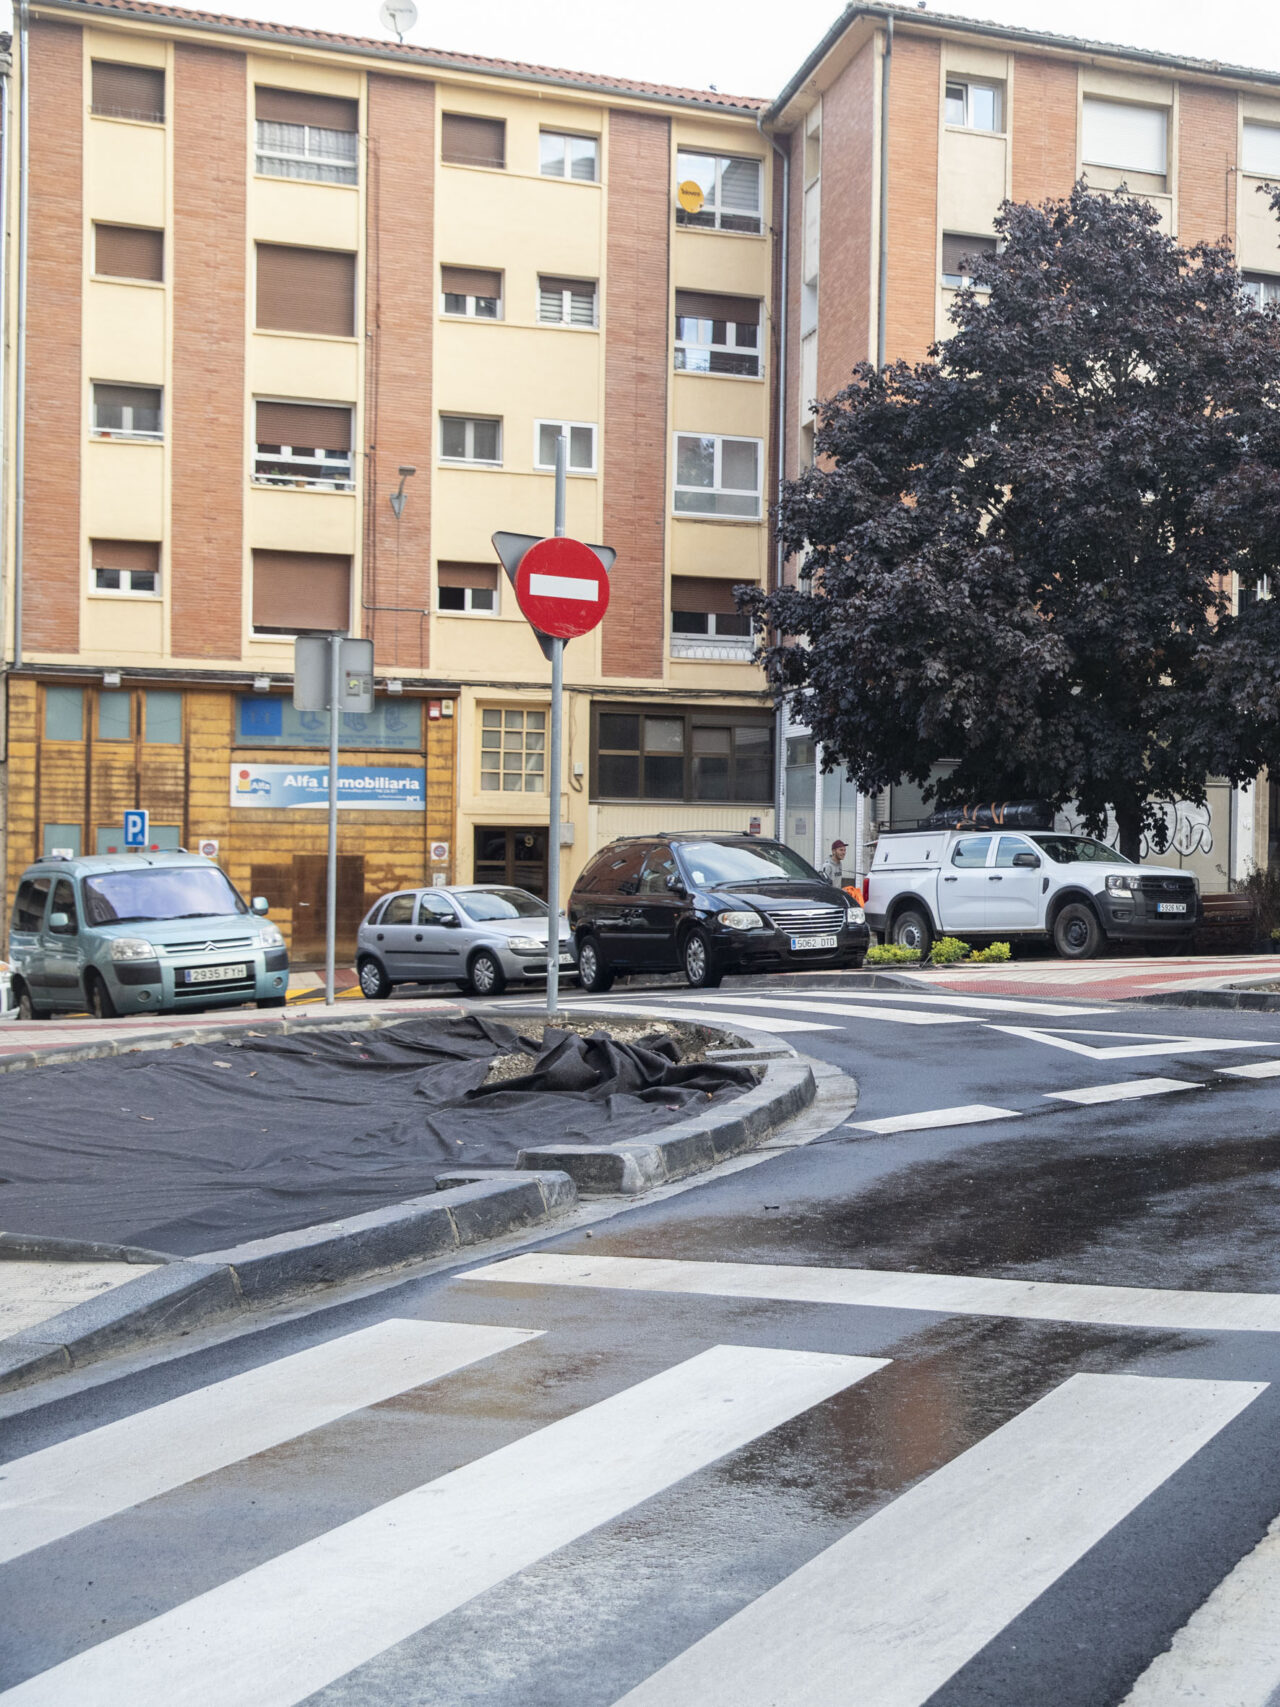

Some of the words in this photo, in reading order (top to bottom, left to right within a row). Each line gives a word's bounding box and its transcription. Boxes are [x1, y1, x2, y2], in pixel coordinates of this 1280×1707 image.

[283, 774, 318, 788] Alfa
[322, 775, 420, 790] Imobiliaria
[127, 815, 142, 842] P
[524, 834, 534, 847] 9
[797, 939, 817, 948] 5062
[192, 970, 220, 981] 2935
[223, 966, 245, 978] FYH
